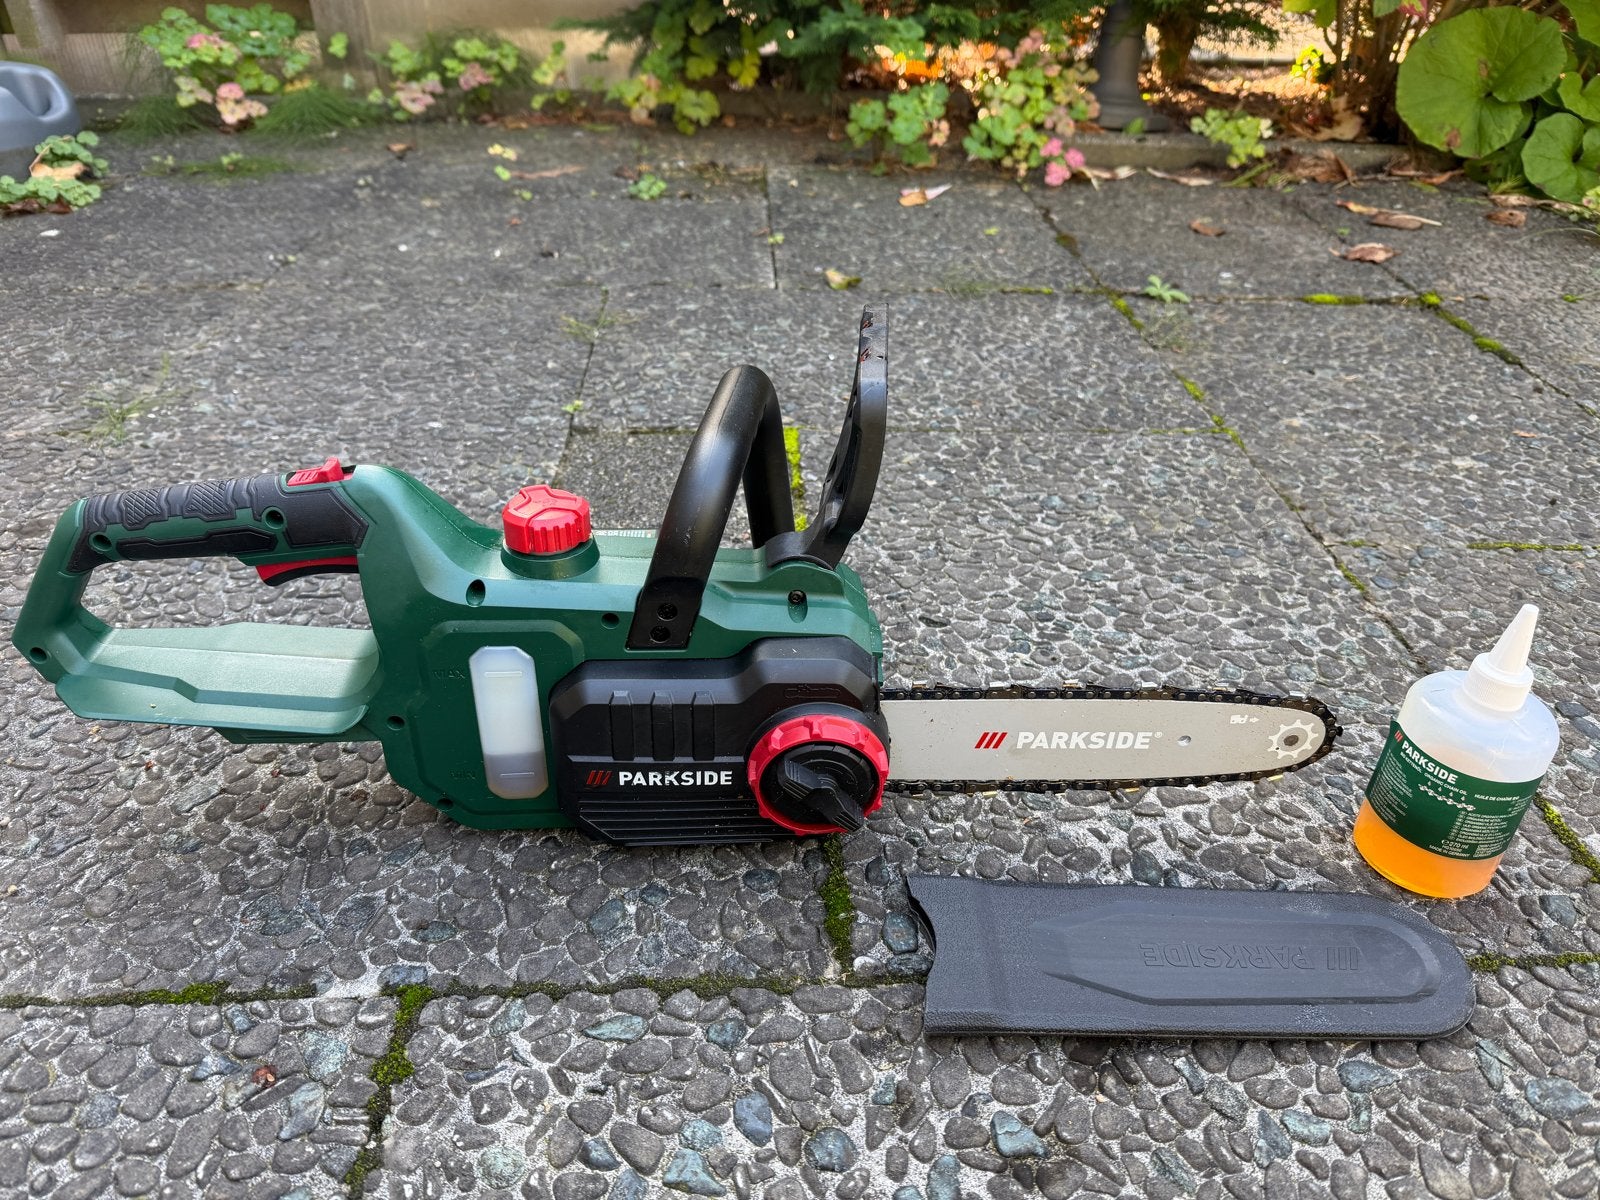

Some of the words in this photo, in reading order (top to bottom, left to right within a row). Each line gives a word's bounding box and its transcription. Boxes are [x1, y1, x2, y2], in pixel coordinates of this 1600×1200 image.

[433, 669, 465, 679] MAX
[1402, 740, 1458, 784] PARKSIDE
[618, 770, 733, 786] PARKSIDE
[1443, 783, 1460, 793] CHAIN
[1140, 943, 1316, 970] PARKSIDE
